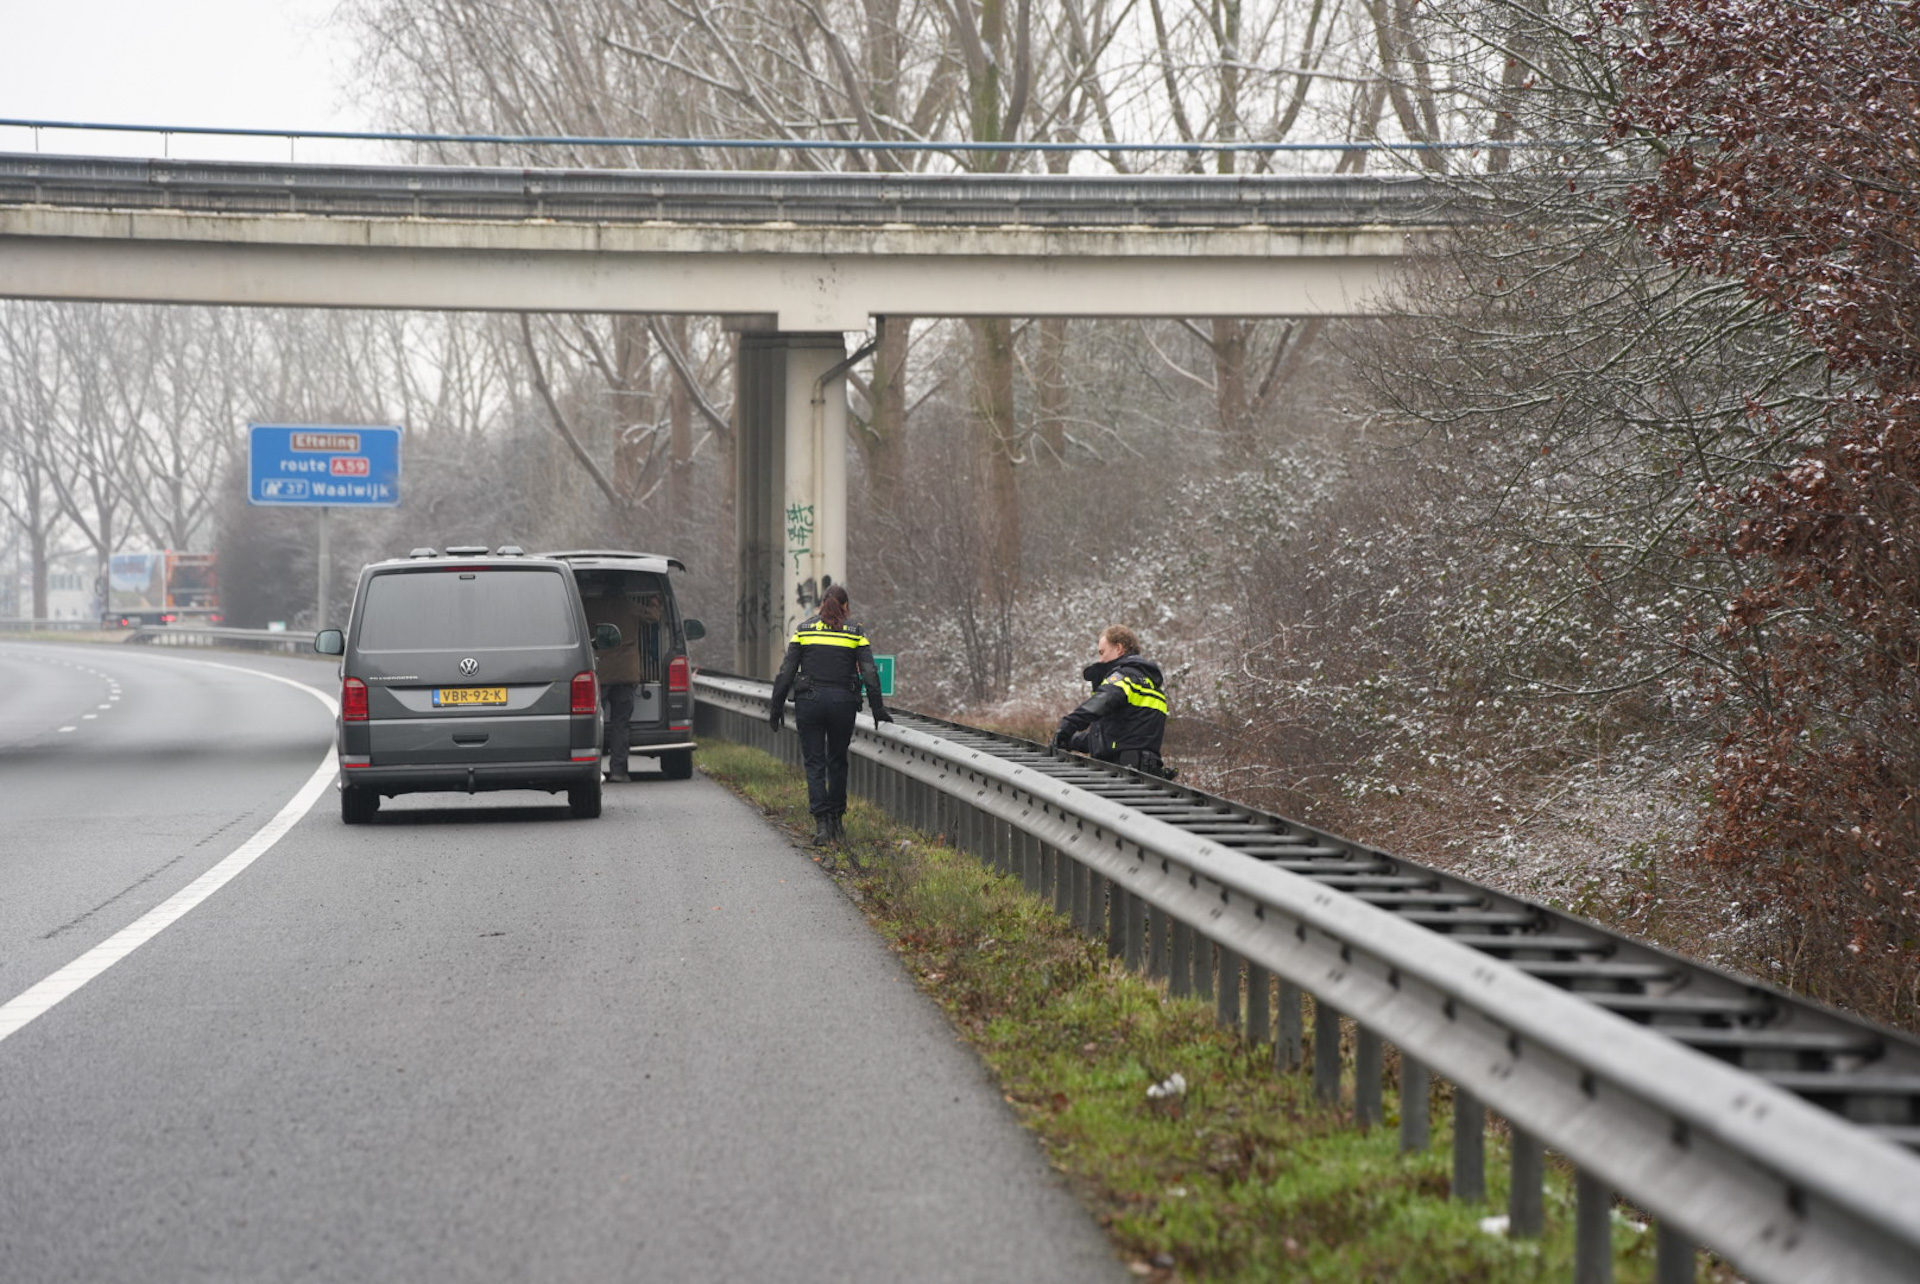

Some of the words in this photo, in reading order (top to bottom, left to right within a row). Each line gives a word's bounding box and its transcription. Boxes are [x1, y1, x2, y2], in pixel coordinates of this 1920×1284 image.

[295, 434, 355, 448] Efteling
[280, 459, 327, 472] route
[333, 461, 366, 473] A59
[311, 482, 389, 500] Waalwijk
[442, 689, 502, 702] VBR-92-K
